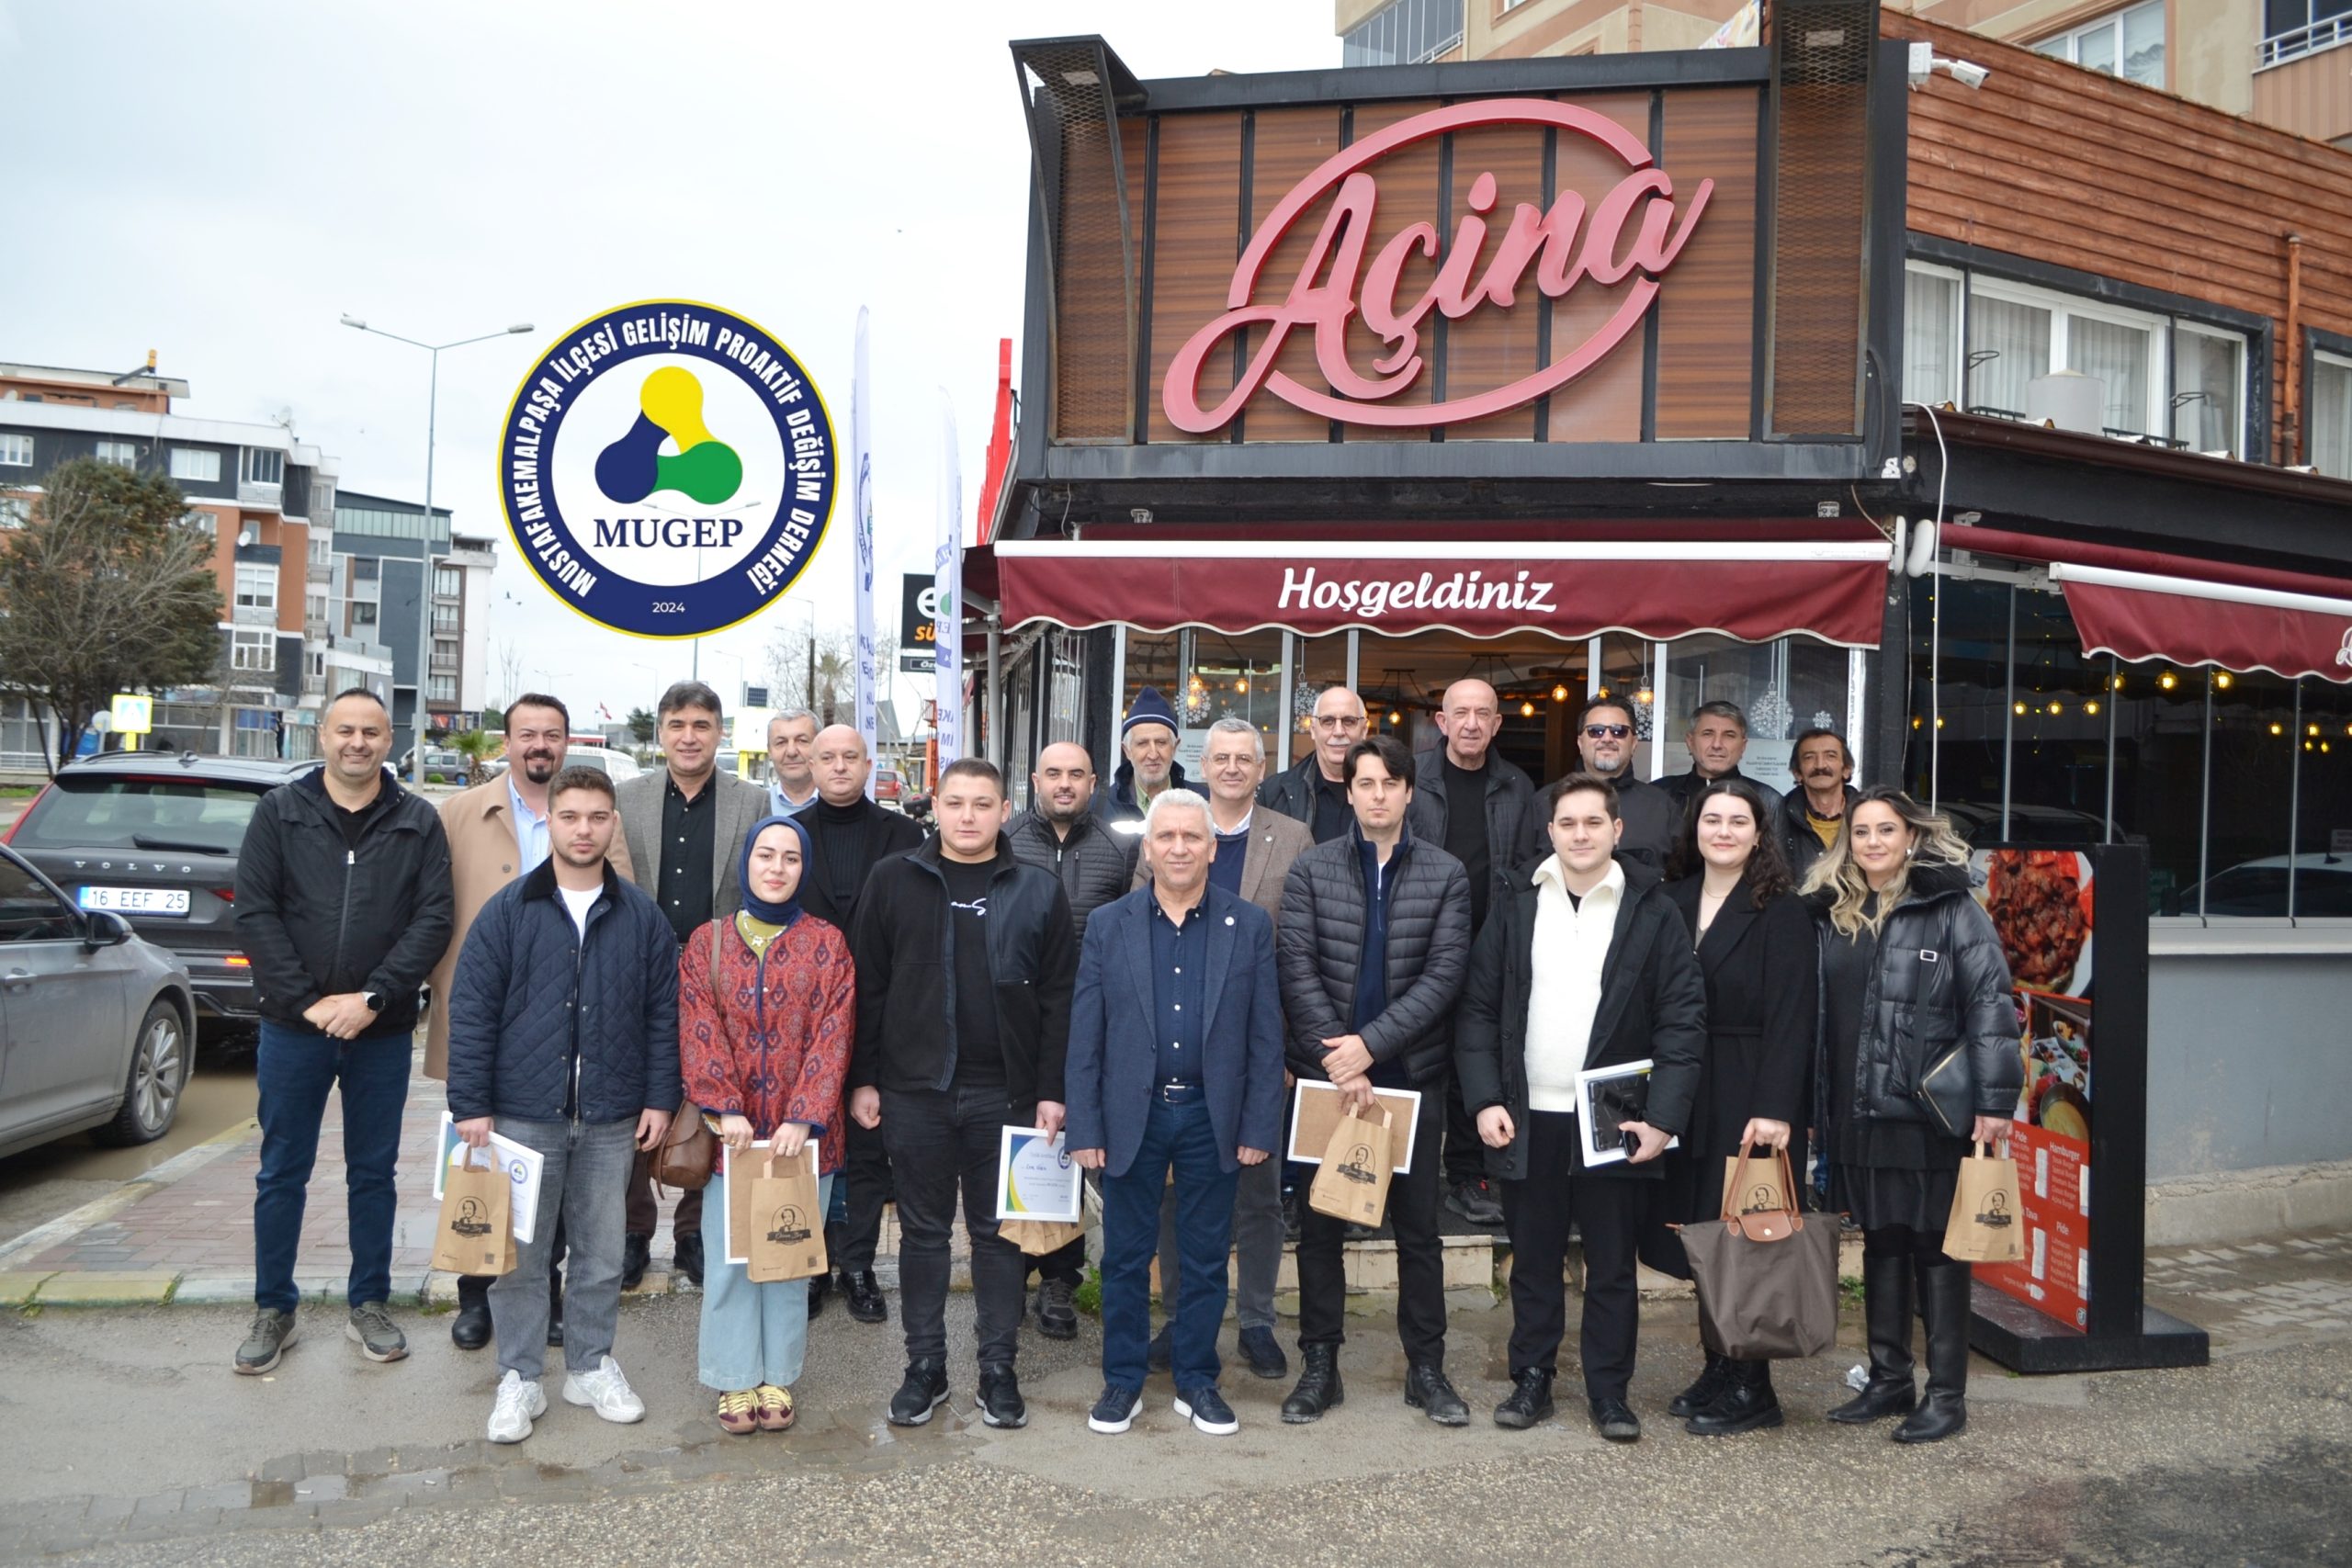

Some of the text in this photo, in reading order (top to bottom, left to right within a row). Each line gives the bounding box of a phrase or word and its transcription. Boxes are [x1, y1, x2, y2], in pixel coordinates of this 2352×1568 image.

[1163, 168, 1715, 434] Açina
[1278, 567, 1557, 618] Hoşgeldiniz
[74, 861, 191, 873] VOLVO
[93, 890, 185, 908] 16 EEF 25
[2049, 1140, 2080, 1162] Hamburger
[2056, 1221, 2069, 1235] Pide
